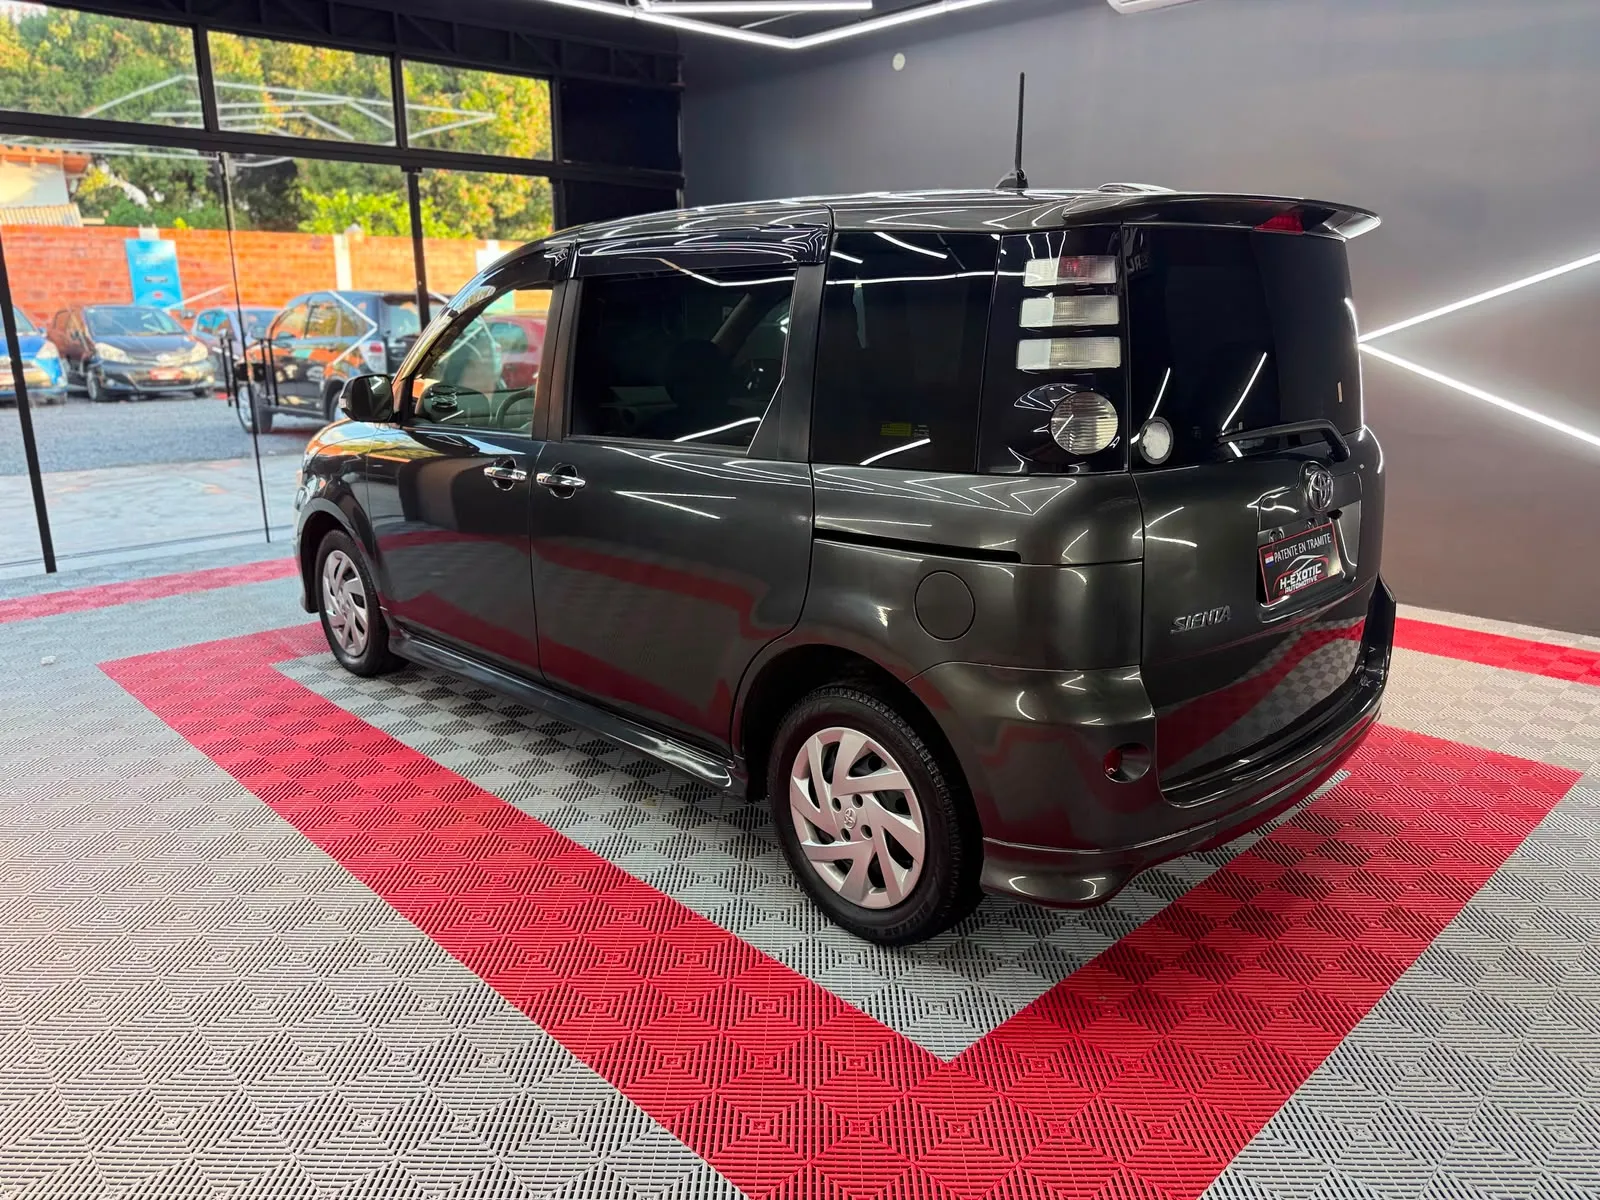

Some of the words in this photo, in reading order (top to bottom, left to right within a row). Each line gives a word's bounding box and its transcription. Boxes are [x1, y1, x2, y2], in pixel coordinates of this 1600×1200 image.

[1274, 545, 1298, 563] PATENTE
[1299, 541, 1307, 554] EN
[1306, 533, 1332, 550] TRAMITE
[1280, 563, 1322, 589] H-EXOTIC
[1285, 575, 1318, 594] AUTOMOTIVE
[1171, 605, 1231, 633] SIENTA
